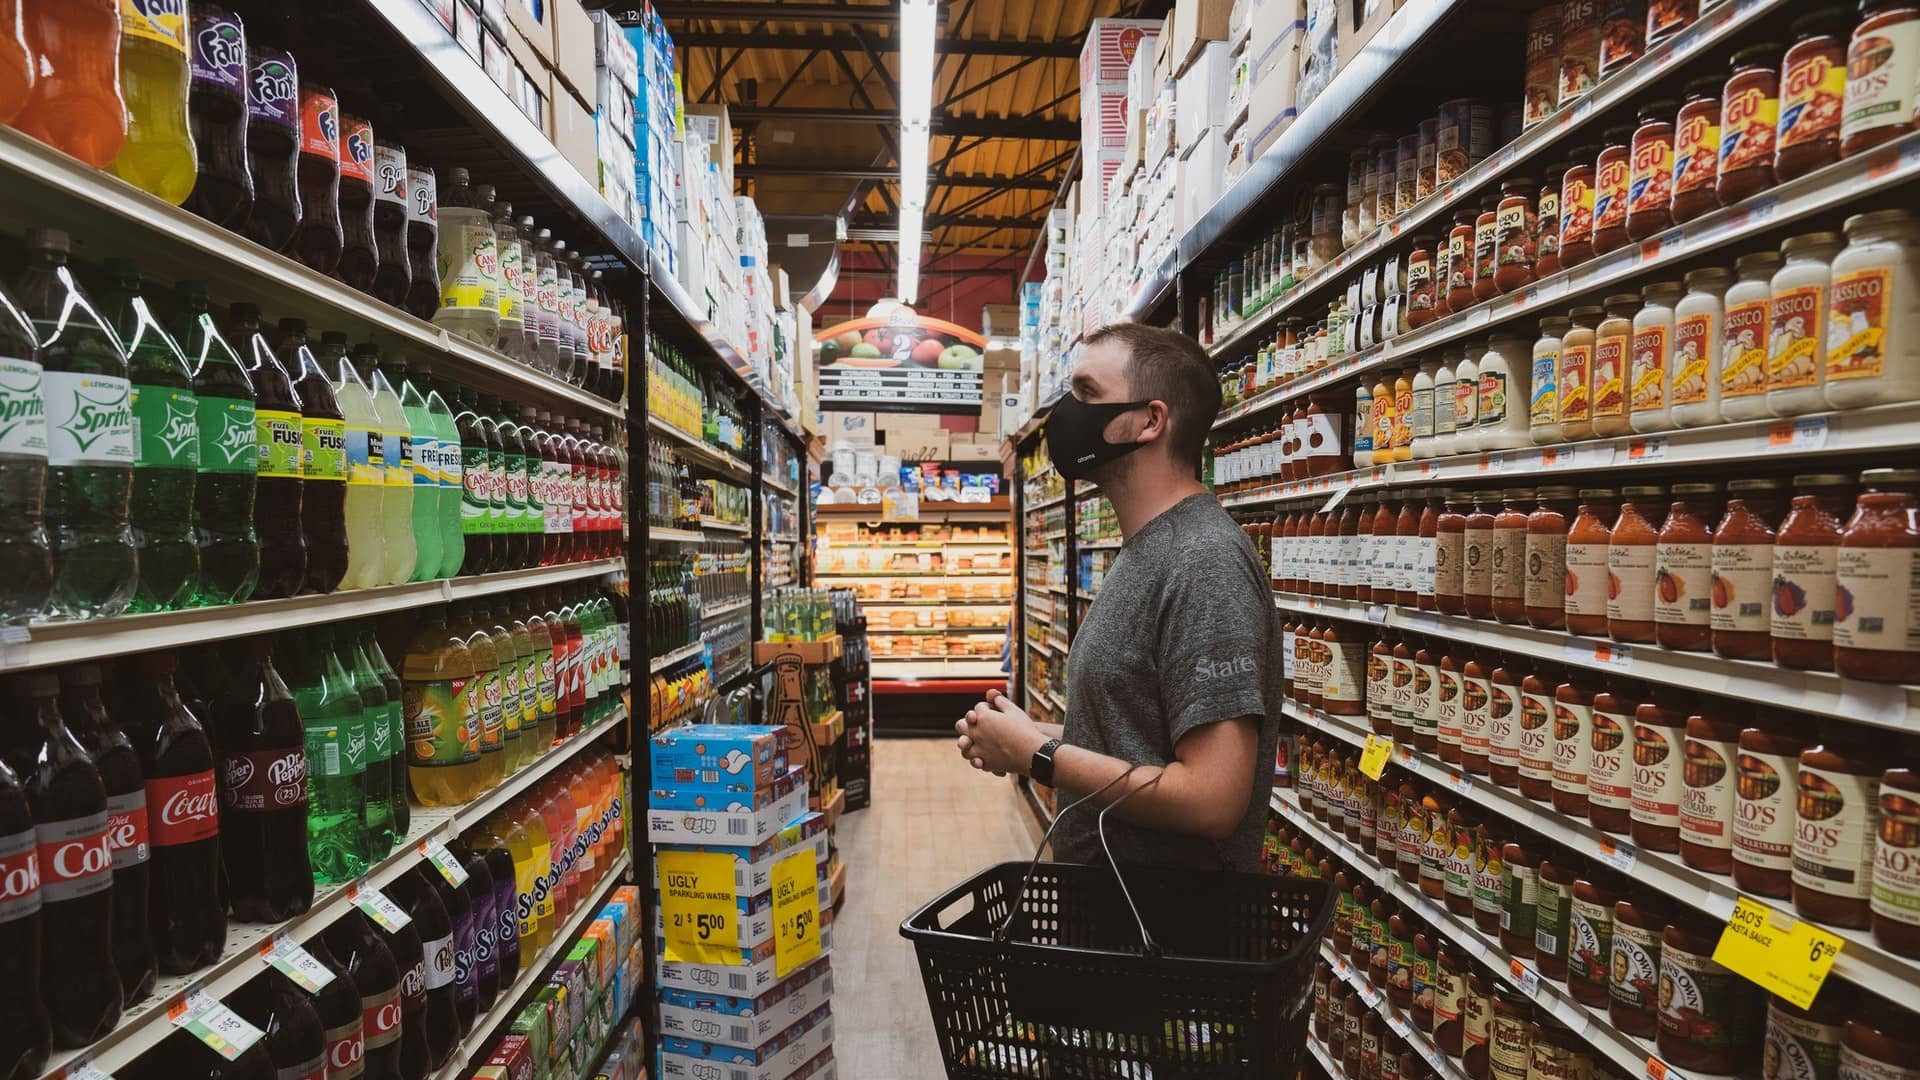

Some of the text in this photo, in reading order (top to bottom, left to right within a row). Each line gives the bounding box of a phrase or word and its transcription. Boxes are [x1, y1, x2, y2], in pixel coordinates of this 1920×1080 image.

[684, 816, 717, 835] ugly
[667, 875, 699, 889] UGLY
[777, 879, 796, 900] UGLY
[669, 889, 731, 902] SPARKLING WATER
[1732, 905, 1764, 929] RAO'S
[1749, 930, 1773, 948] SAUCE
[690, 967, 719, 985] ugly
[692, 1018, 721, 1036] ugly
